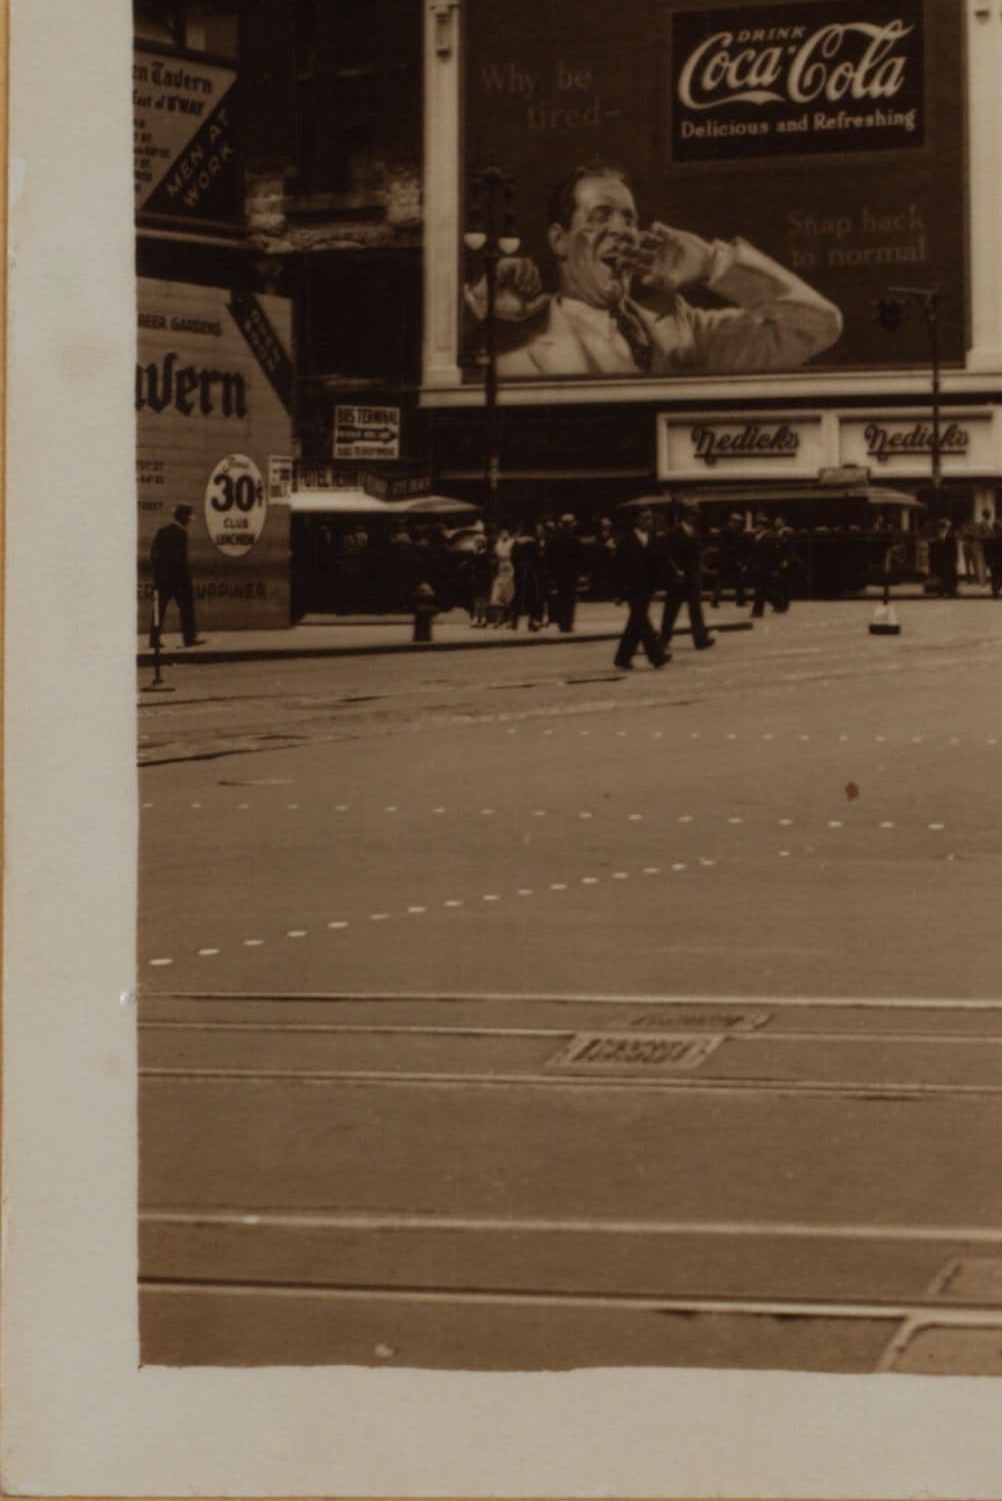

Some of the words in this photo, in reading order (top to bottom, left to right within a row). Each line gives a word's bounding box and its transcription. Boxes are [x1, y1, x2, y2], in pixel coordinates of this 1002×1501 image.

[737, 25, 806, 44] DRINK
[152, 59, 213, 94] Tavern
[480, 62, 541, 100] Why
[557, 59, 592, 91] be
[681, 118, 768, 139] Delicious
[776, 114, 808, 133] and
[813, 107, 917, 132] Refreshing
